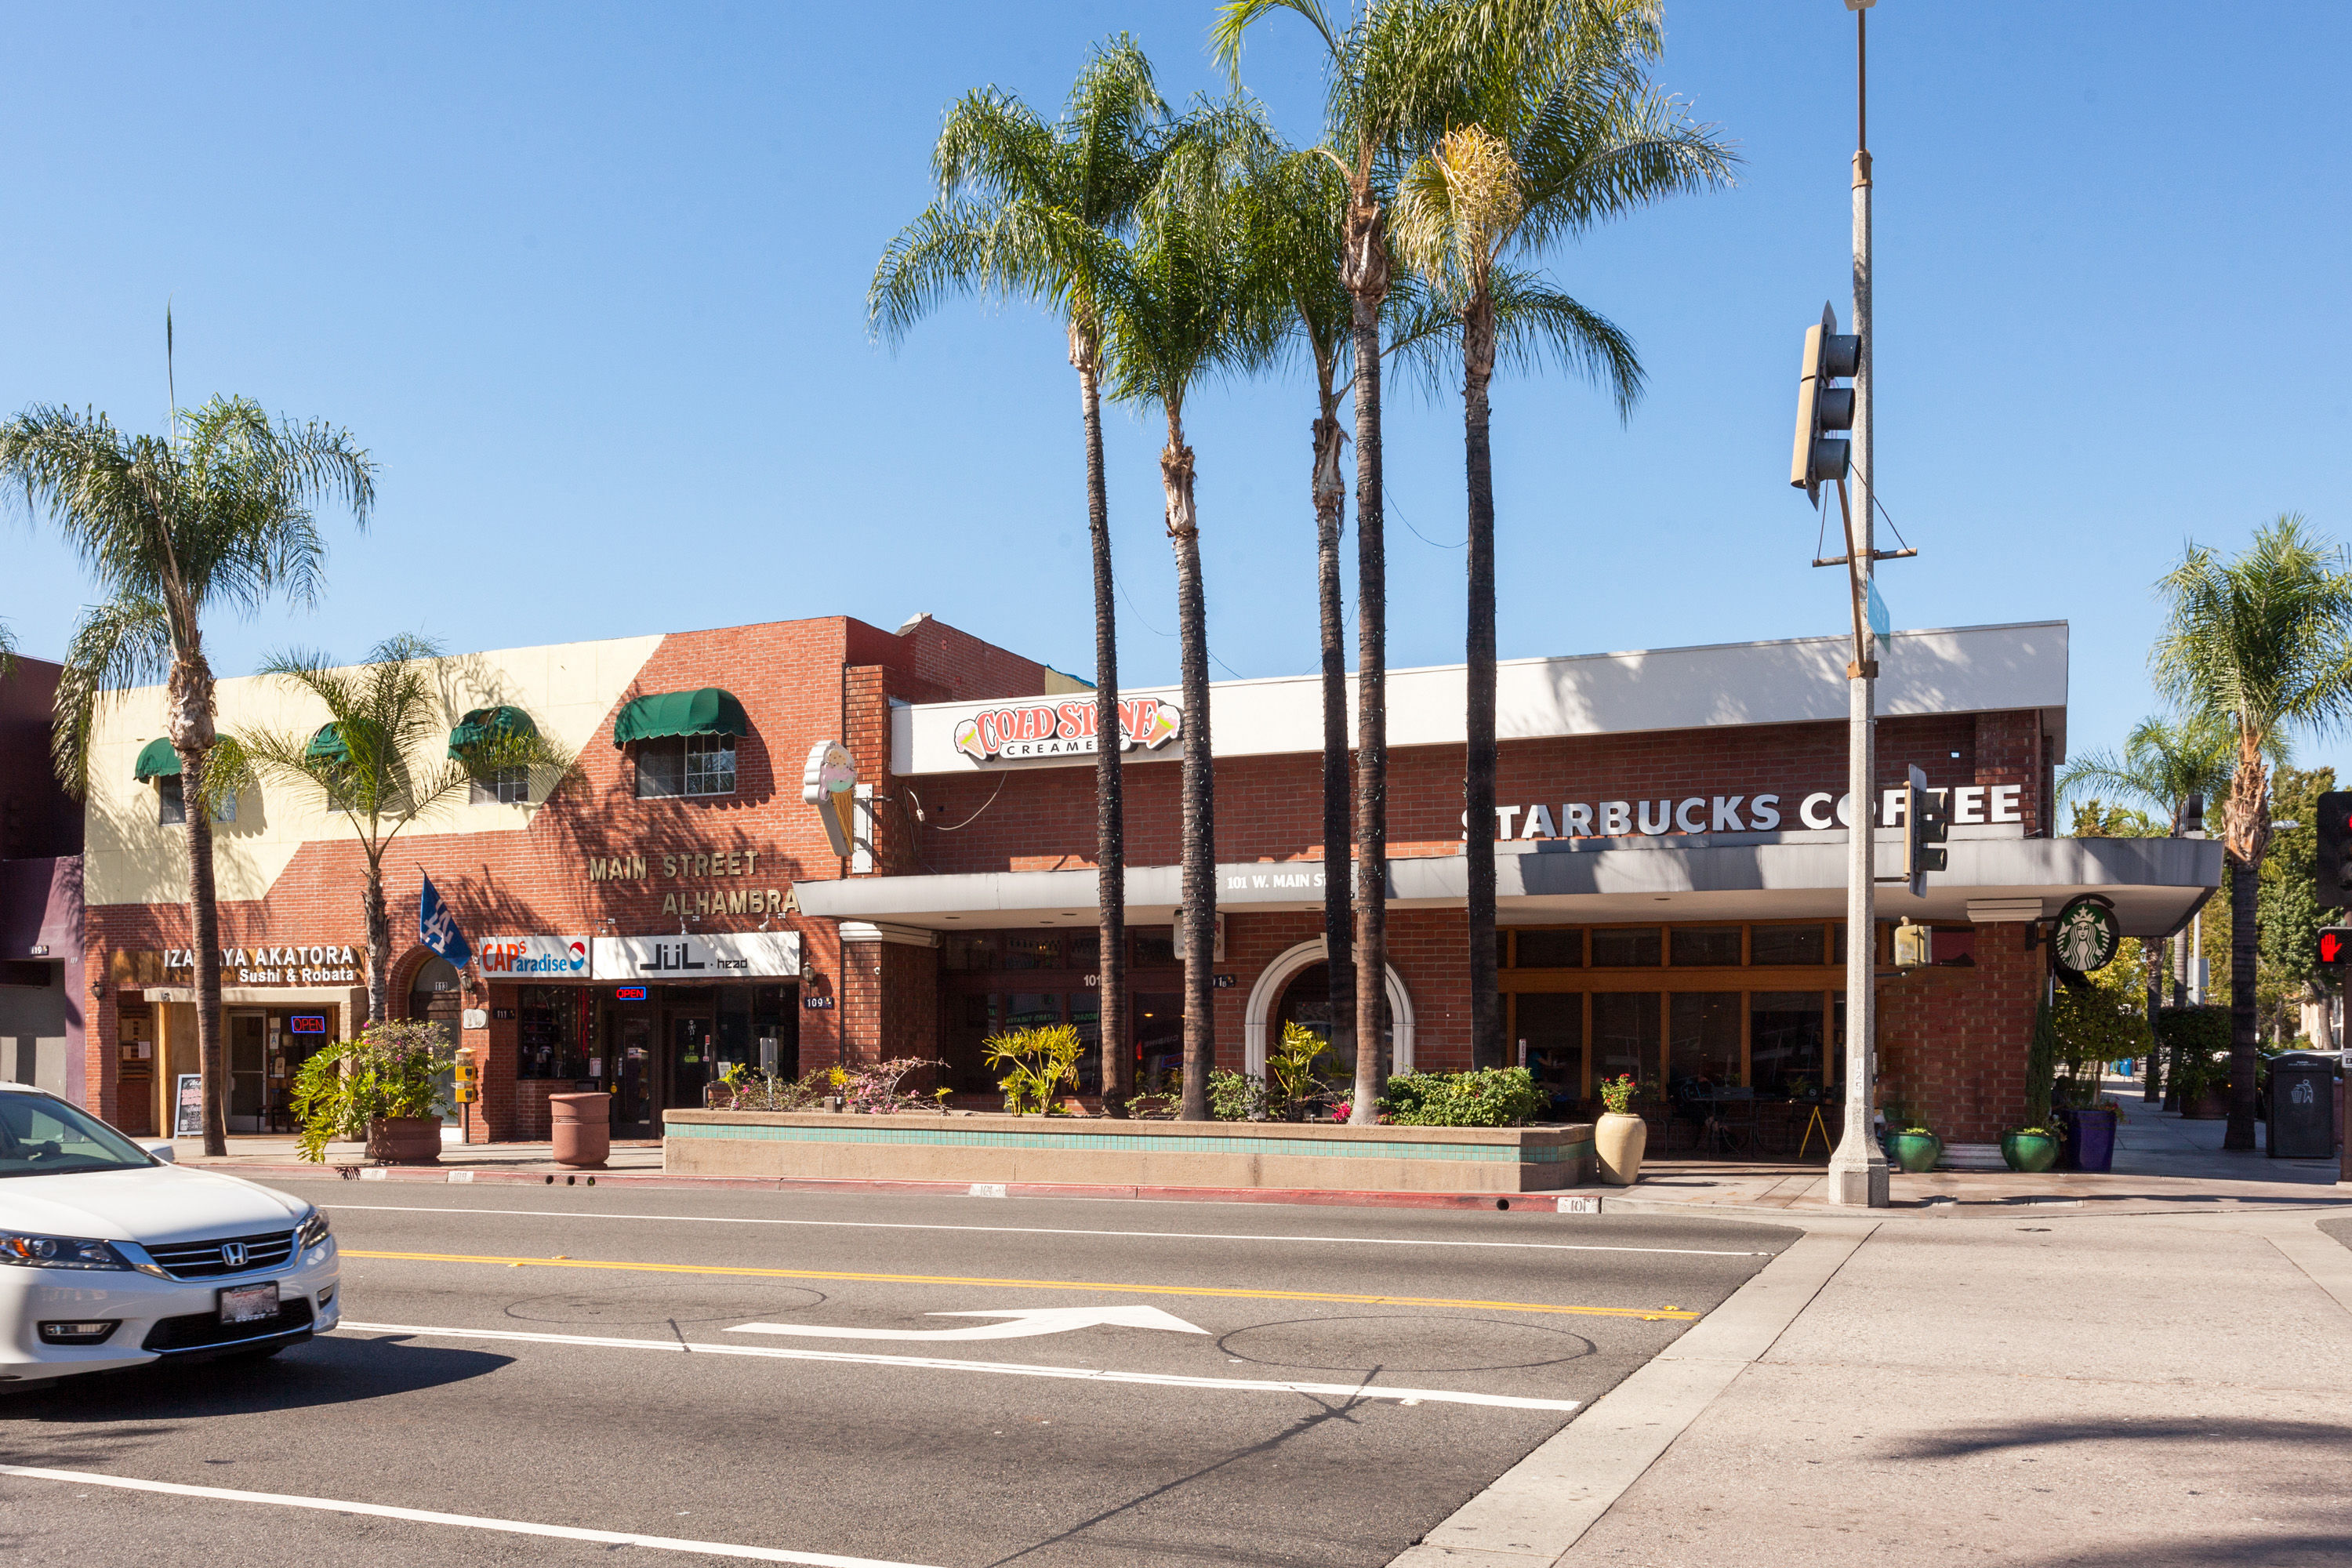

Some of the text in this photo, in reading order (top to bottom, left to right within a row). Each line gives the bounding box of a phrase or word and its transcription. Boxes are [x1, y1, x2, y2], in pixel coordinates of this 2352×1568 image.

[977, 700, 1159, 753] COLD STNE
[1007, 739, 1123, 755] CREAME
[1800, 784, 2021, 829] CFEE
[590, 851, 758, 881] MAIN STREET
[1227, 876, 1247, 889] 101
[1252, 875, 1269, 888] W.
[1273, 873, 1310, 888] MAIN
[662, 888, 801, 915] ALHAMBRA
[31, 946, 42, 954] 119
[164, 945, 354, 967] IZAYA AKATORA
[239, 967, 354, 983] Sushi & Robata
[1083, 975, 1101, 987] 101
[616, 989, 644, 999] OPEN
[807, 997, 823, 1007] 109
[497, 1010, 507, 1019] 111
[293, 1018, 324, 1031] OPEN
